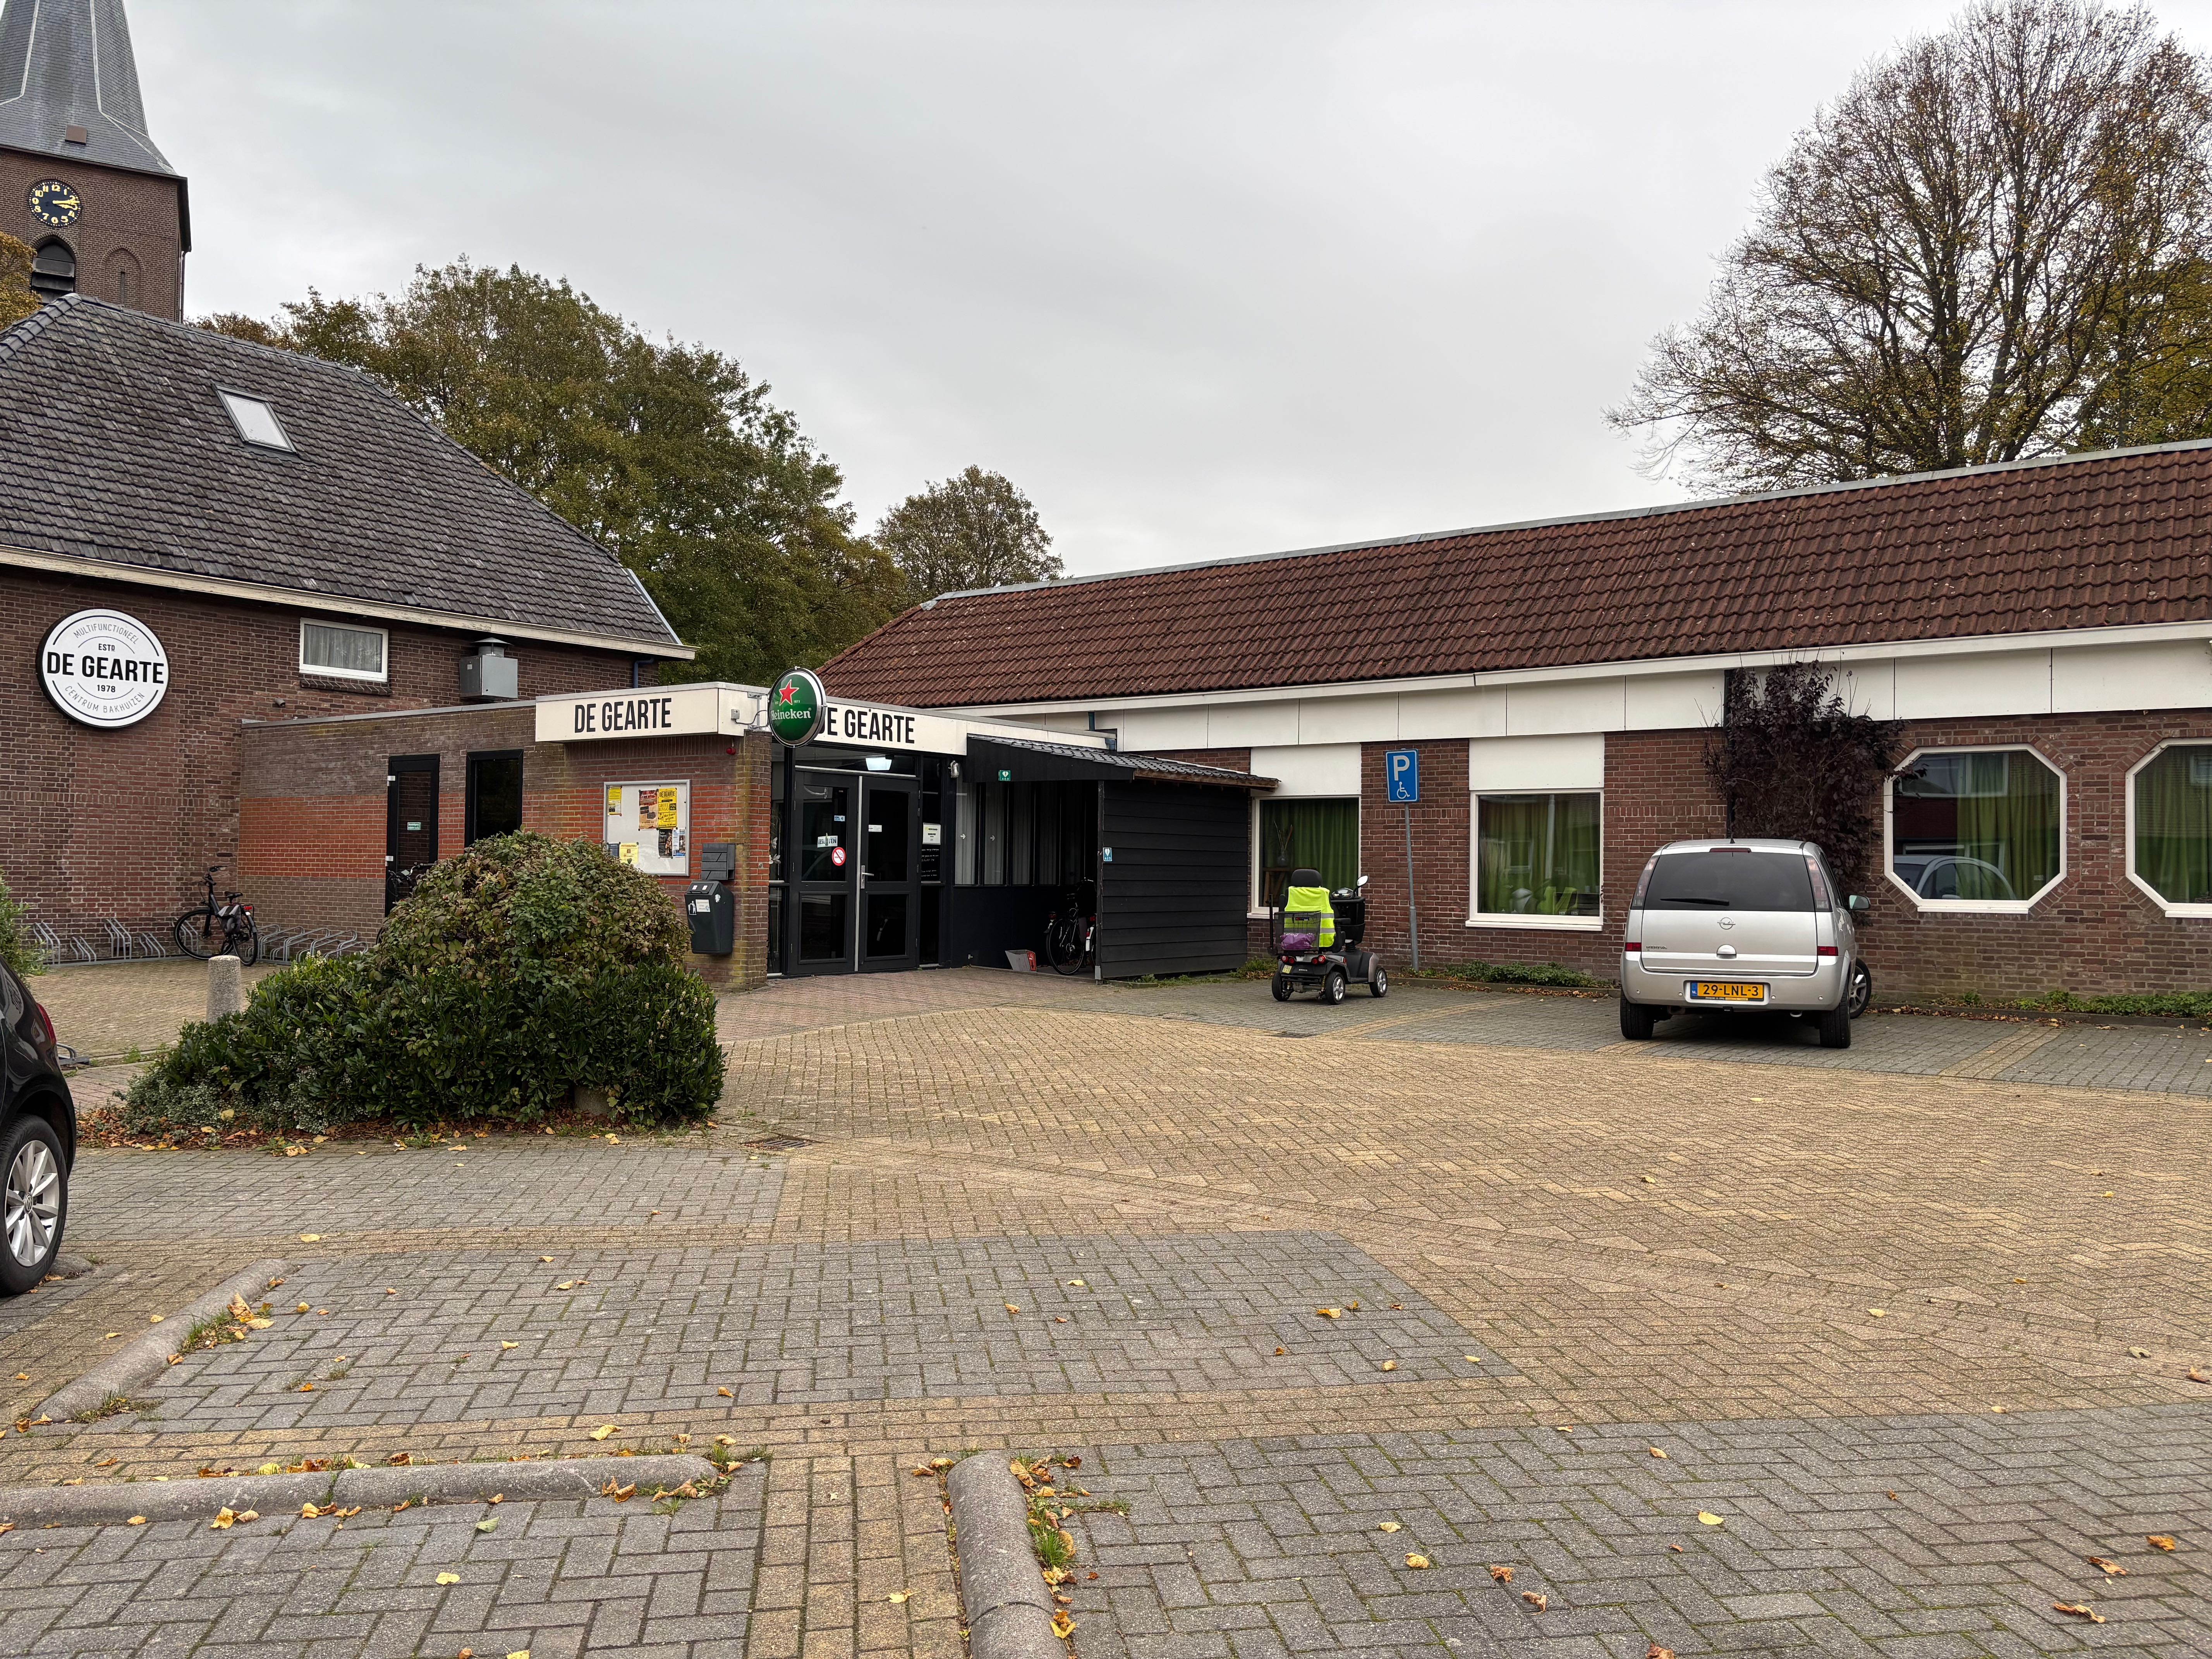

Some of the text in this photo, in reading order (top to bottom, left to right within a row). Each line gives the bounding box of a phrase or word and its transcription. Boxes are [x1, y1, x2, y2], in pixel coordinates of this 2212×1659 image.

[74, 623, 139, 644] MULTIFUNCTIONEEL
[47, 651, 164, 684] DE GEARTE
[65, 686, 145, 713] CENTRUM BAKHUIZEN
[97, 684, 116, 693] 1978
[575, 697, 672, 733] DE GEARTE
[771, 709, 811, 720] Heineken
[818, 707, 915, 744] E GEARTE
[1393, 755, 1410, 781] P
[1703, 984, 1759, 996] 29-LNL-3
